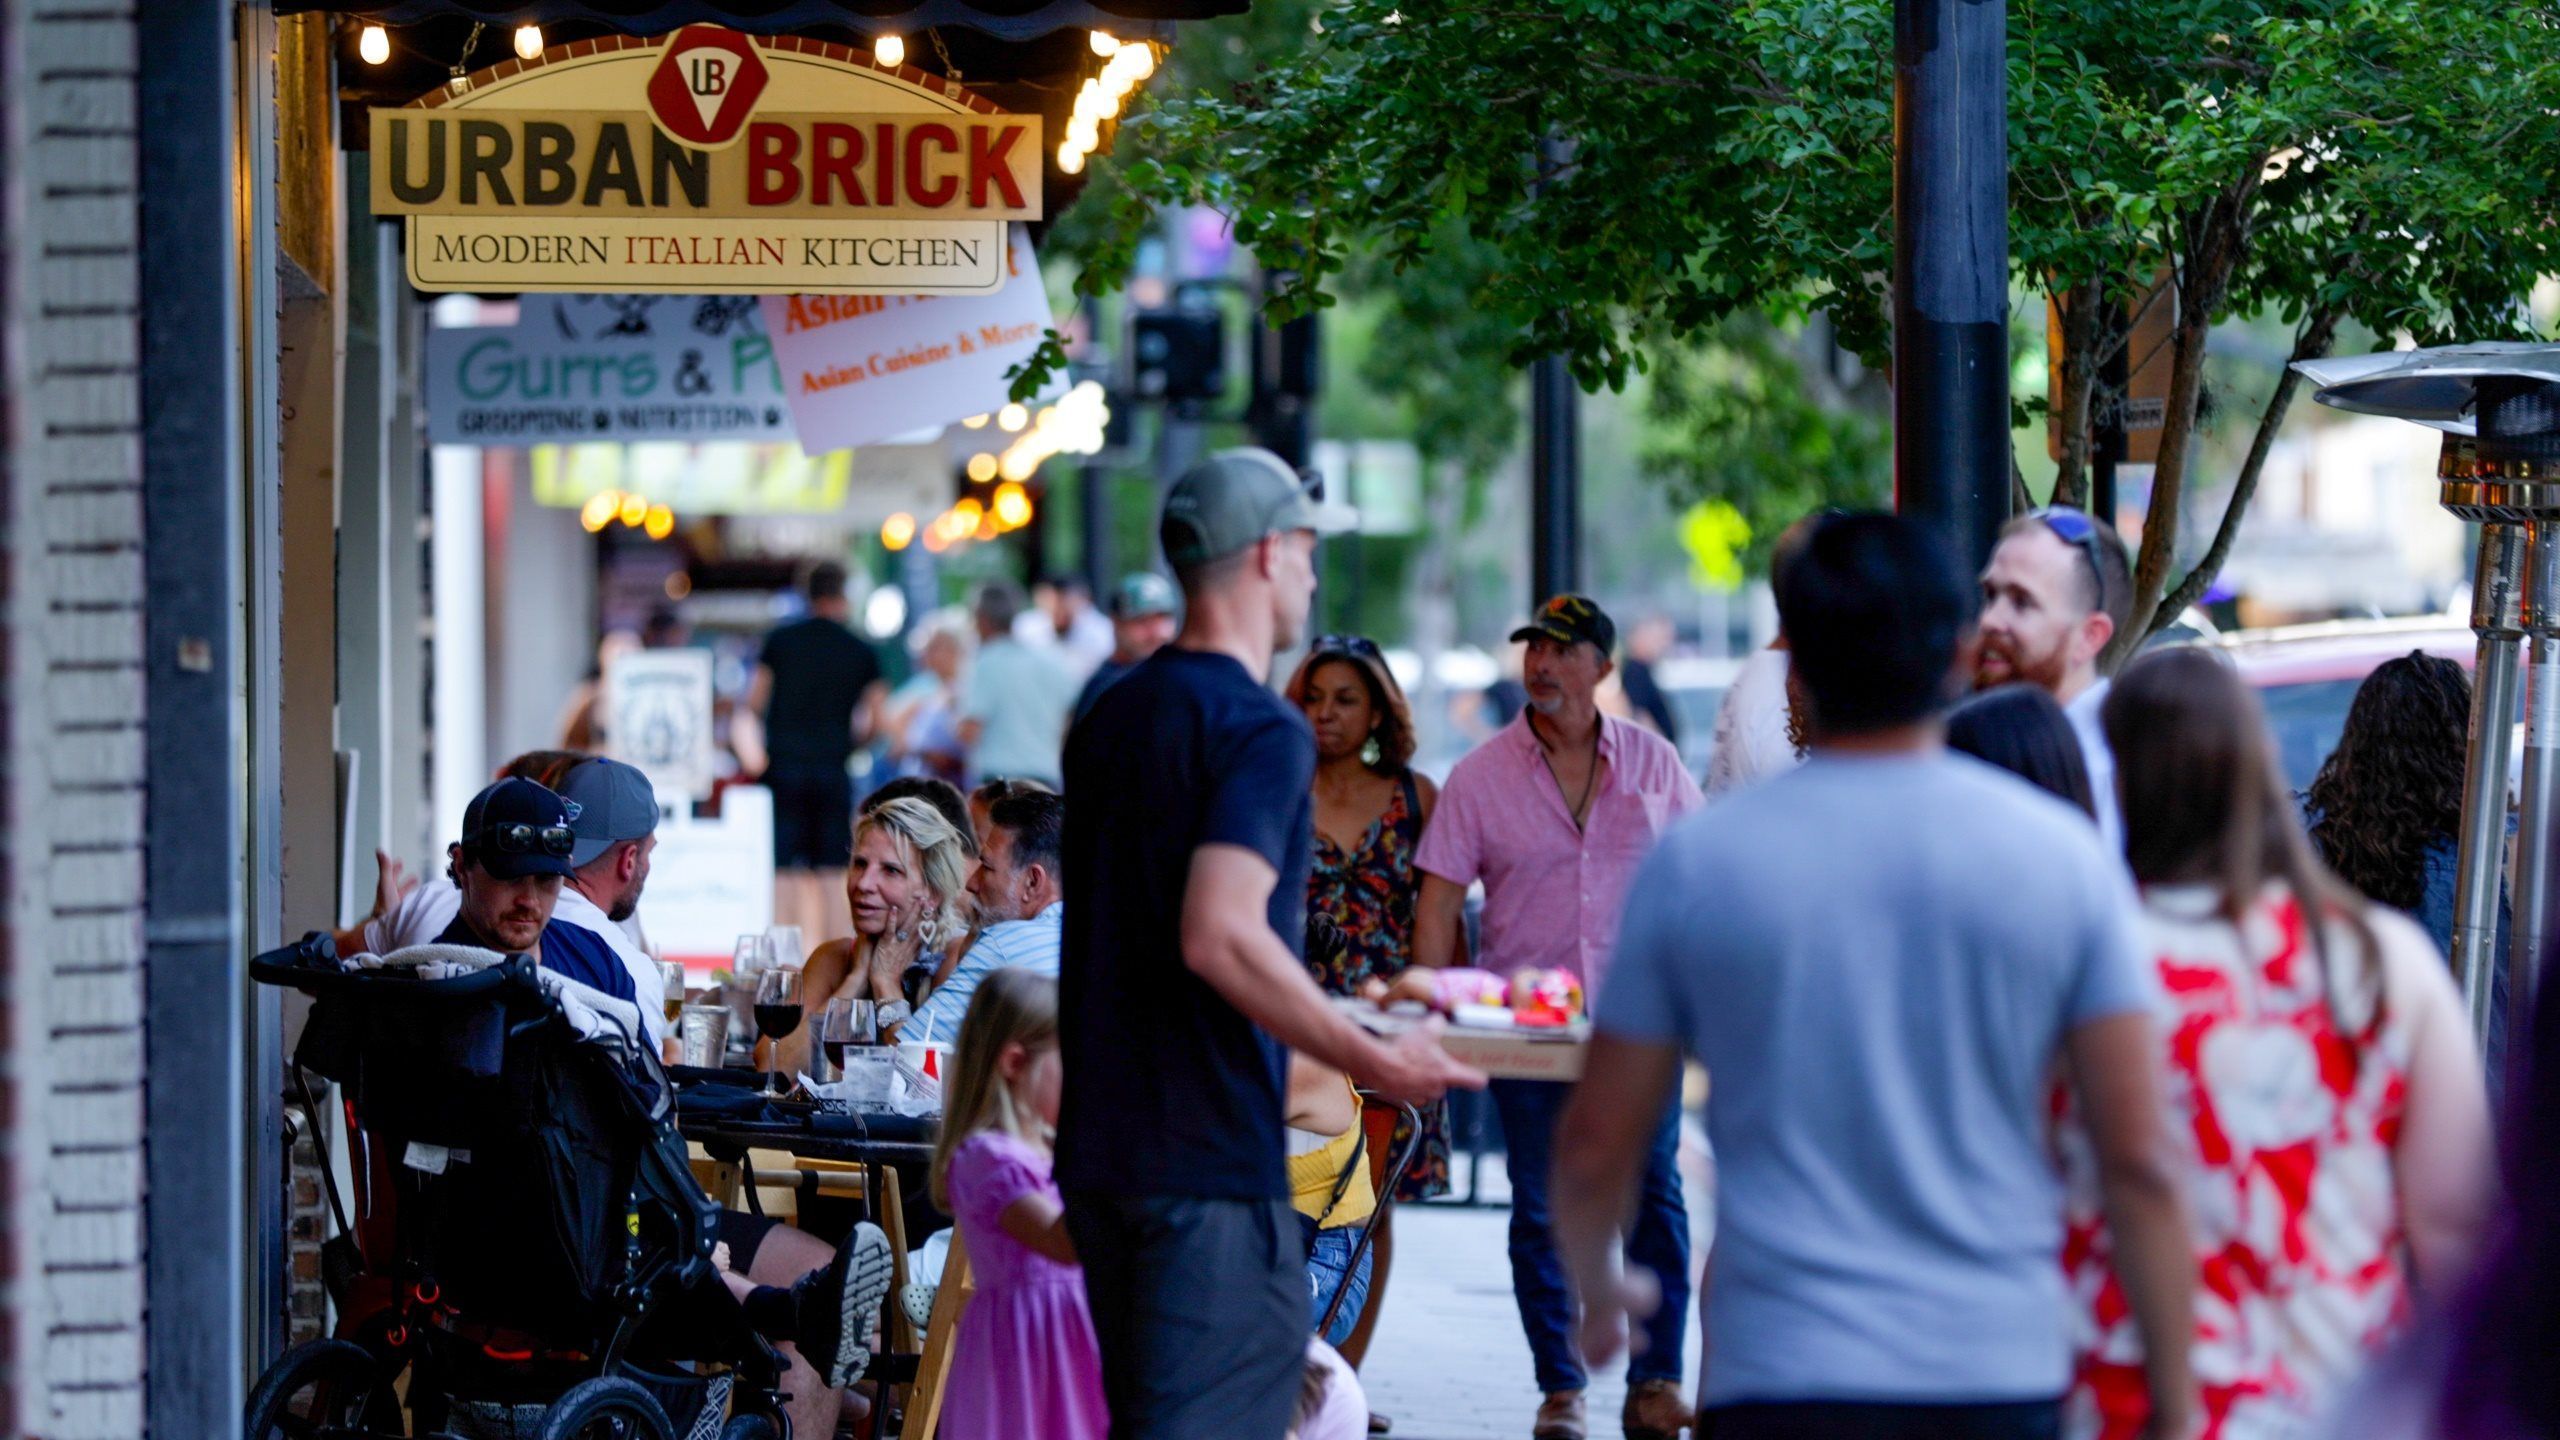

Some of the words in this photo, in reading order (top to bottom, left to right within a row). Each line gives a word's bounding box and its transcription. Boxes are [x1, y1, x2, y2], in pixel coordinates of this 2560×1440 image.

[692, 58, 726, 95] UB
[388, 117, 710, 208] URBAN
[746, 122, 1026, 208] BRICK
[432, 234, 609, 266] MODERN
[624, 236, 786, 266] ITALIAN
[801, 238, 980, 268] KITCHEN
[457, 336, 659, 401] Gurrs
[674, 349, 713, 397] &
[803, 363, 865, 395] Asian
[867, 341, 952, 378] Cuisine
[958, 332, 976, 355] &
[979, 322, 1039, 349] More
